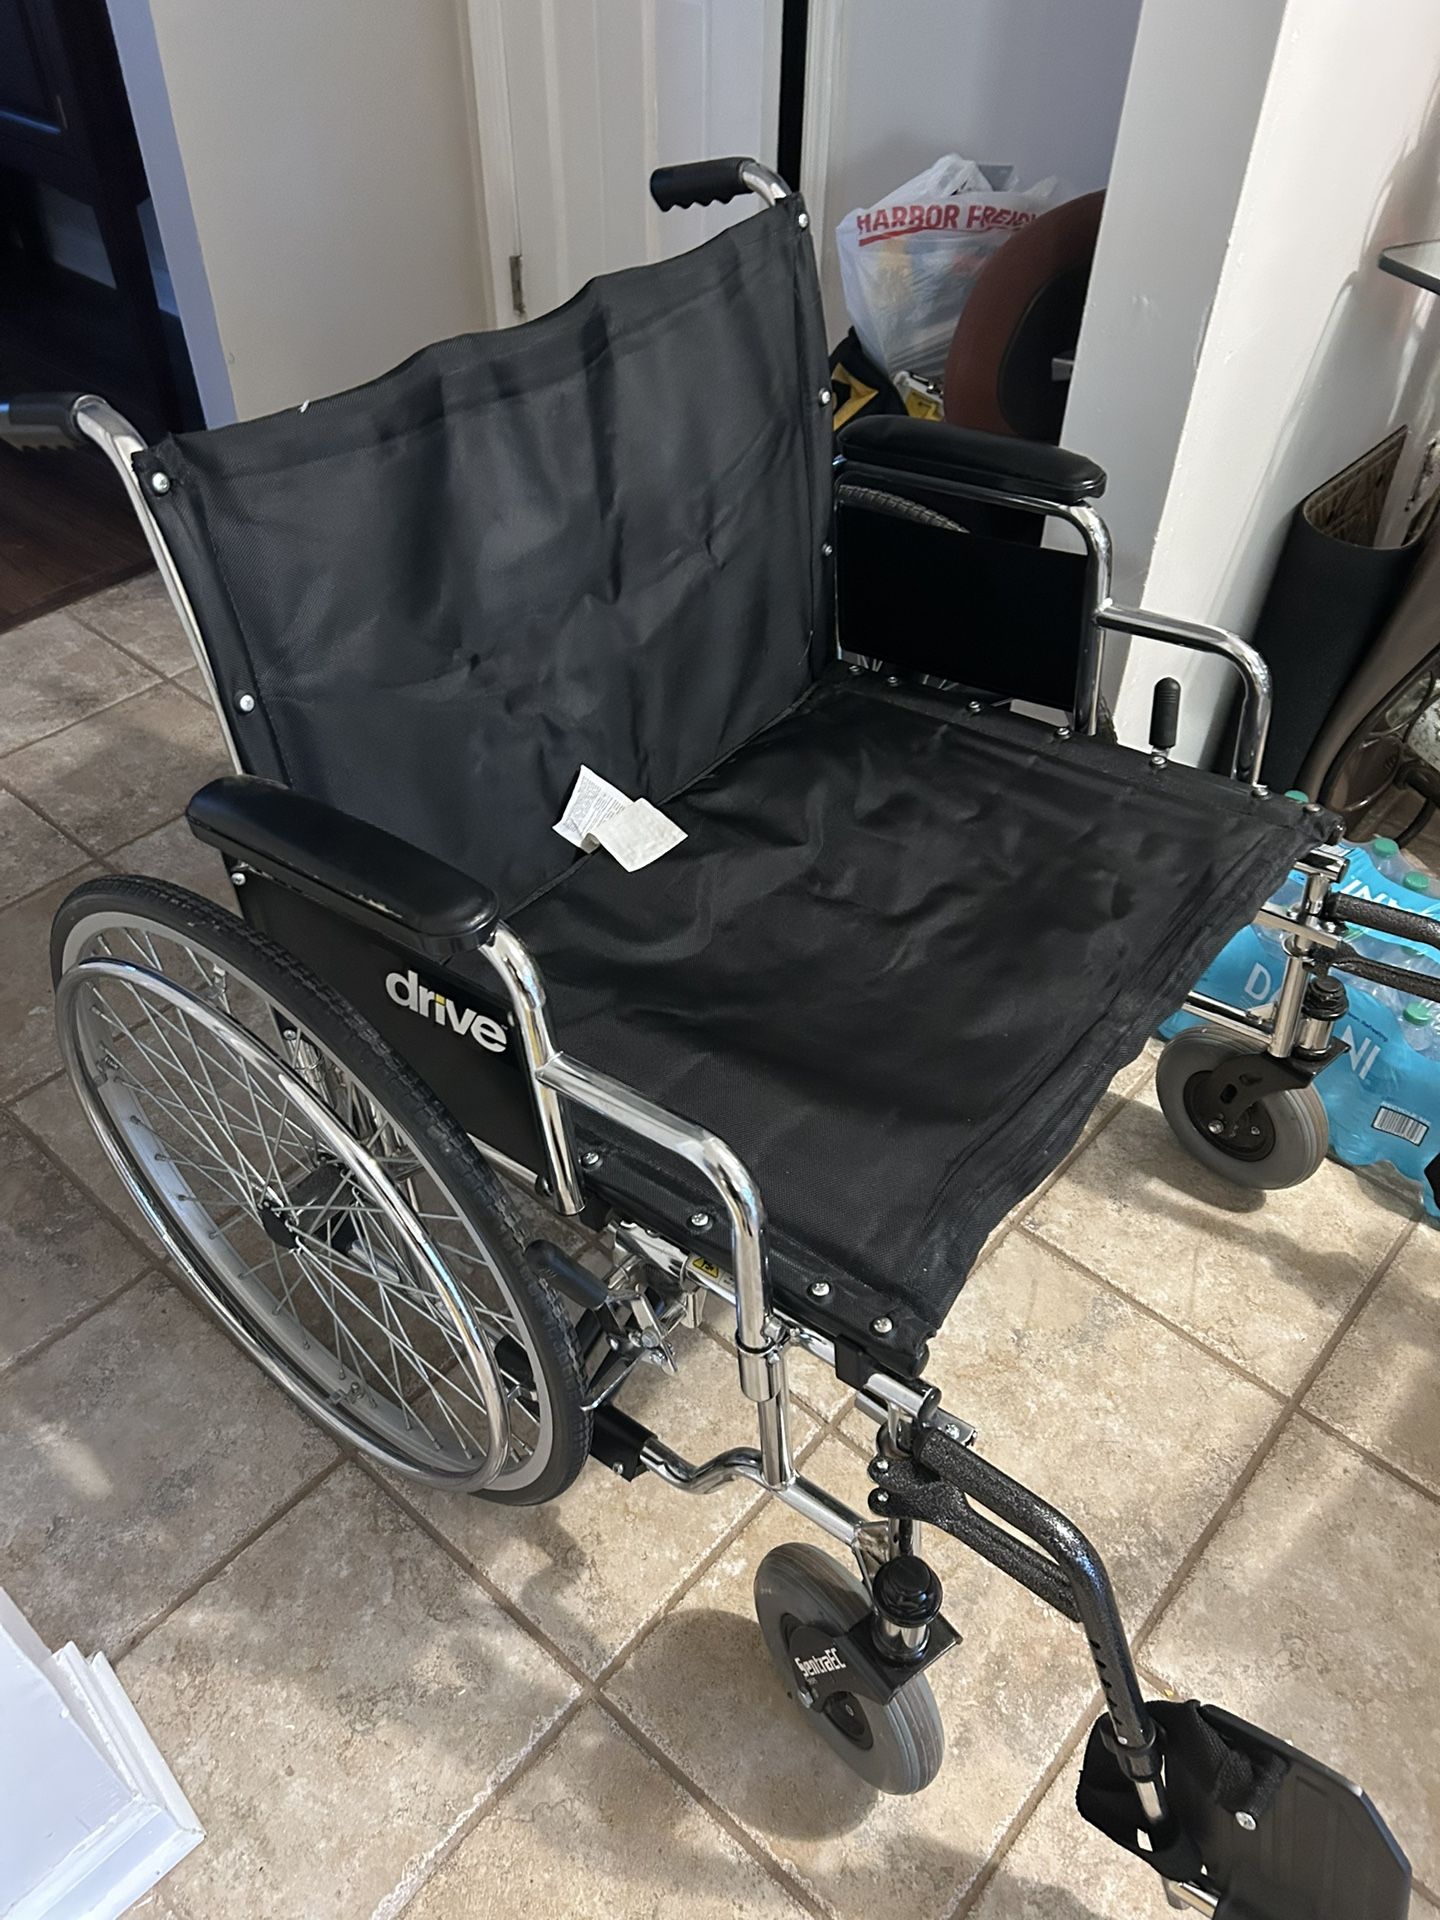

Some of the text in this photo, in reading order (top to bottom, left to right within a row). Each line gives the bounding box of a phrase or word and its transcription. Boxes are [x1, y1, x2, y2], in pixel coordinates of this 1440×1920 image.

[856, 204, 960, 235] HARBOR
[385, 969, 507, 1053] drive
[1244, 962, 1382, 1081] DNI
